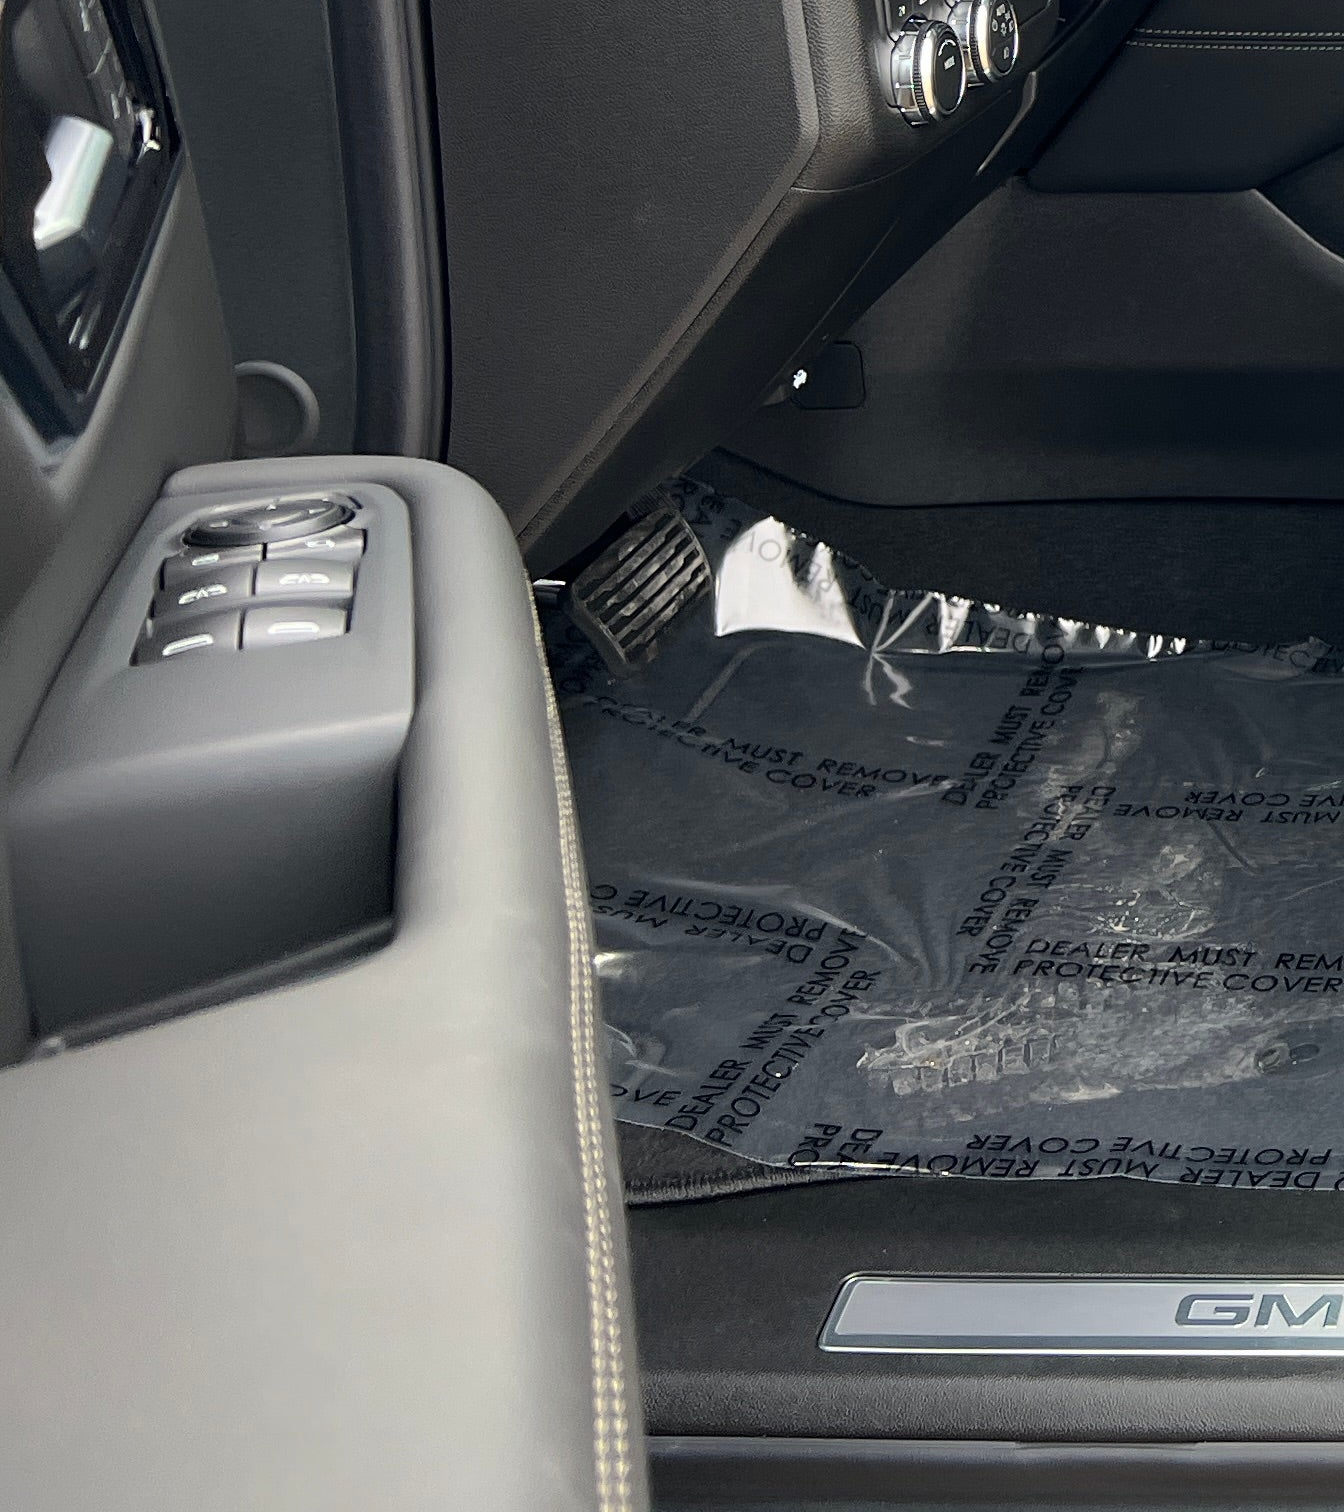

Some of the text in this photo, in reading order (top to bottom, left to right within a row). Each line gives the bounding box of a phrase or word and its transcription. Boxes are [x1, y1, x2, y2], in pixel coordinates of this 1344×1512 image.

[721, 737, 803, 766] MUST
[816, 758, 950, 788] REMOVE
[766, 768, 878, 799] COVER
[1184, 790, 1291, 808] COVER
[1114, 801, 1244, 824] REMOVE
[1259, 808, 1341, 825] MUST
[624, 888, 828, 942] PROTECTIVE
[956, 876, 1017, 937] COVER
[593, 904, 813, 965] DEALER MUS
[969, 898, 1040, 974] REMOVE
[1024, 937, 1151, 963] DEALER
[1167, 945, 1259, 968] MUST
[1012, 958, 1344, 994] PROTECTIVE COVER
[664, 927, 868, 1132] DEALER MUST REMOVE
[704, 1026, 826, 1148] PROTECTIVE
[966, 1133, 1335, 1167] PROTECTIVE COVER
[1057, 1157, 1161, 1179] MUST
[1179, 1165, 1320, 1191] DEALER
